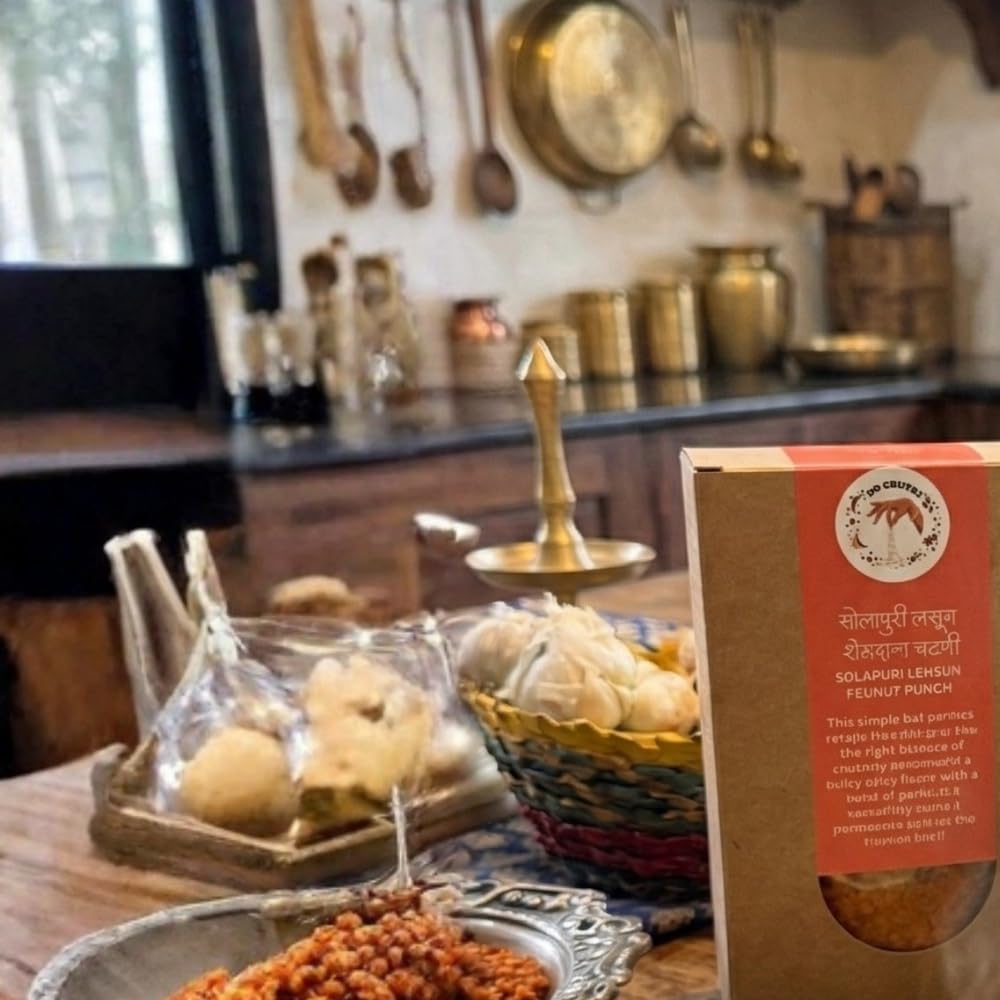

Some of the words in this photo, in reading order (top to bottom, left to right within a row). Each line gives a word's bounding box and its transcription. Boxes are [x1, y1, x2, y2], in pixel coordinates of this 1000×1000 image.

[838, 603, 907, 636] सोलापुरी
[835, 668, 904, 684] SOLAPURI
[908, 665, 961, 680] LEHSUN
[847, 685, 900, 700] FEUNUT
[905, 682, 953, 696] PUNCH
[826, 717, 854, 728] This
[857, 713, 900, 728] simple
[840, 747, 862, 759] the
[865, 745, 896, 759] right
[951, 739, 965, 751] of
[940, 769, 968, 781] with
[882, 790, 895, 801] of
